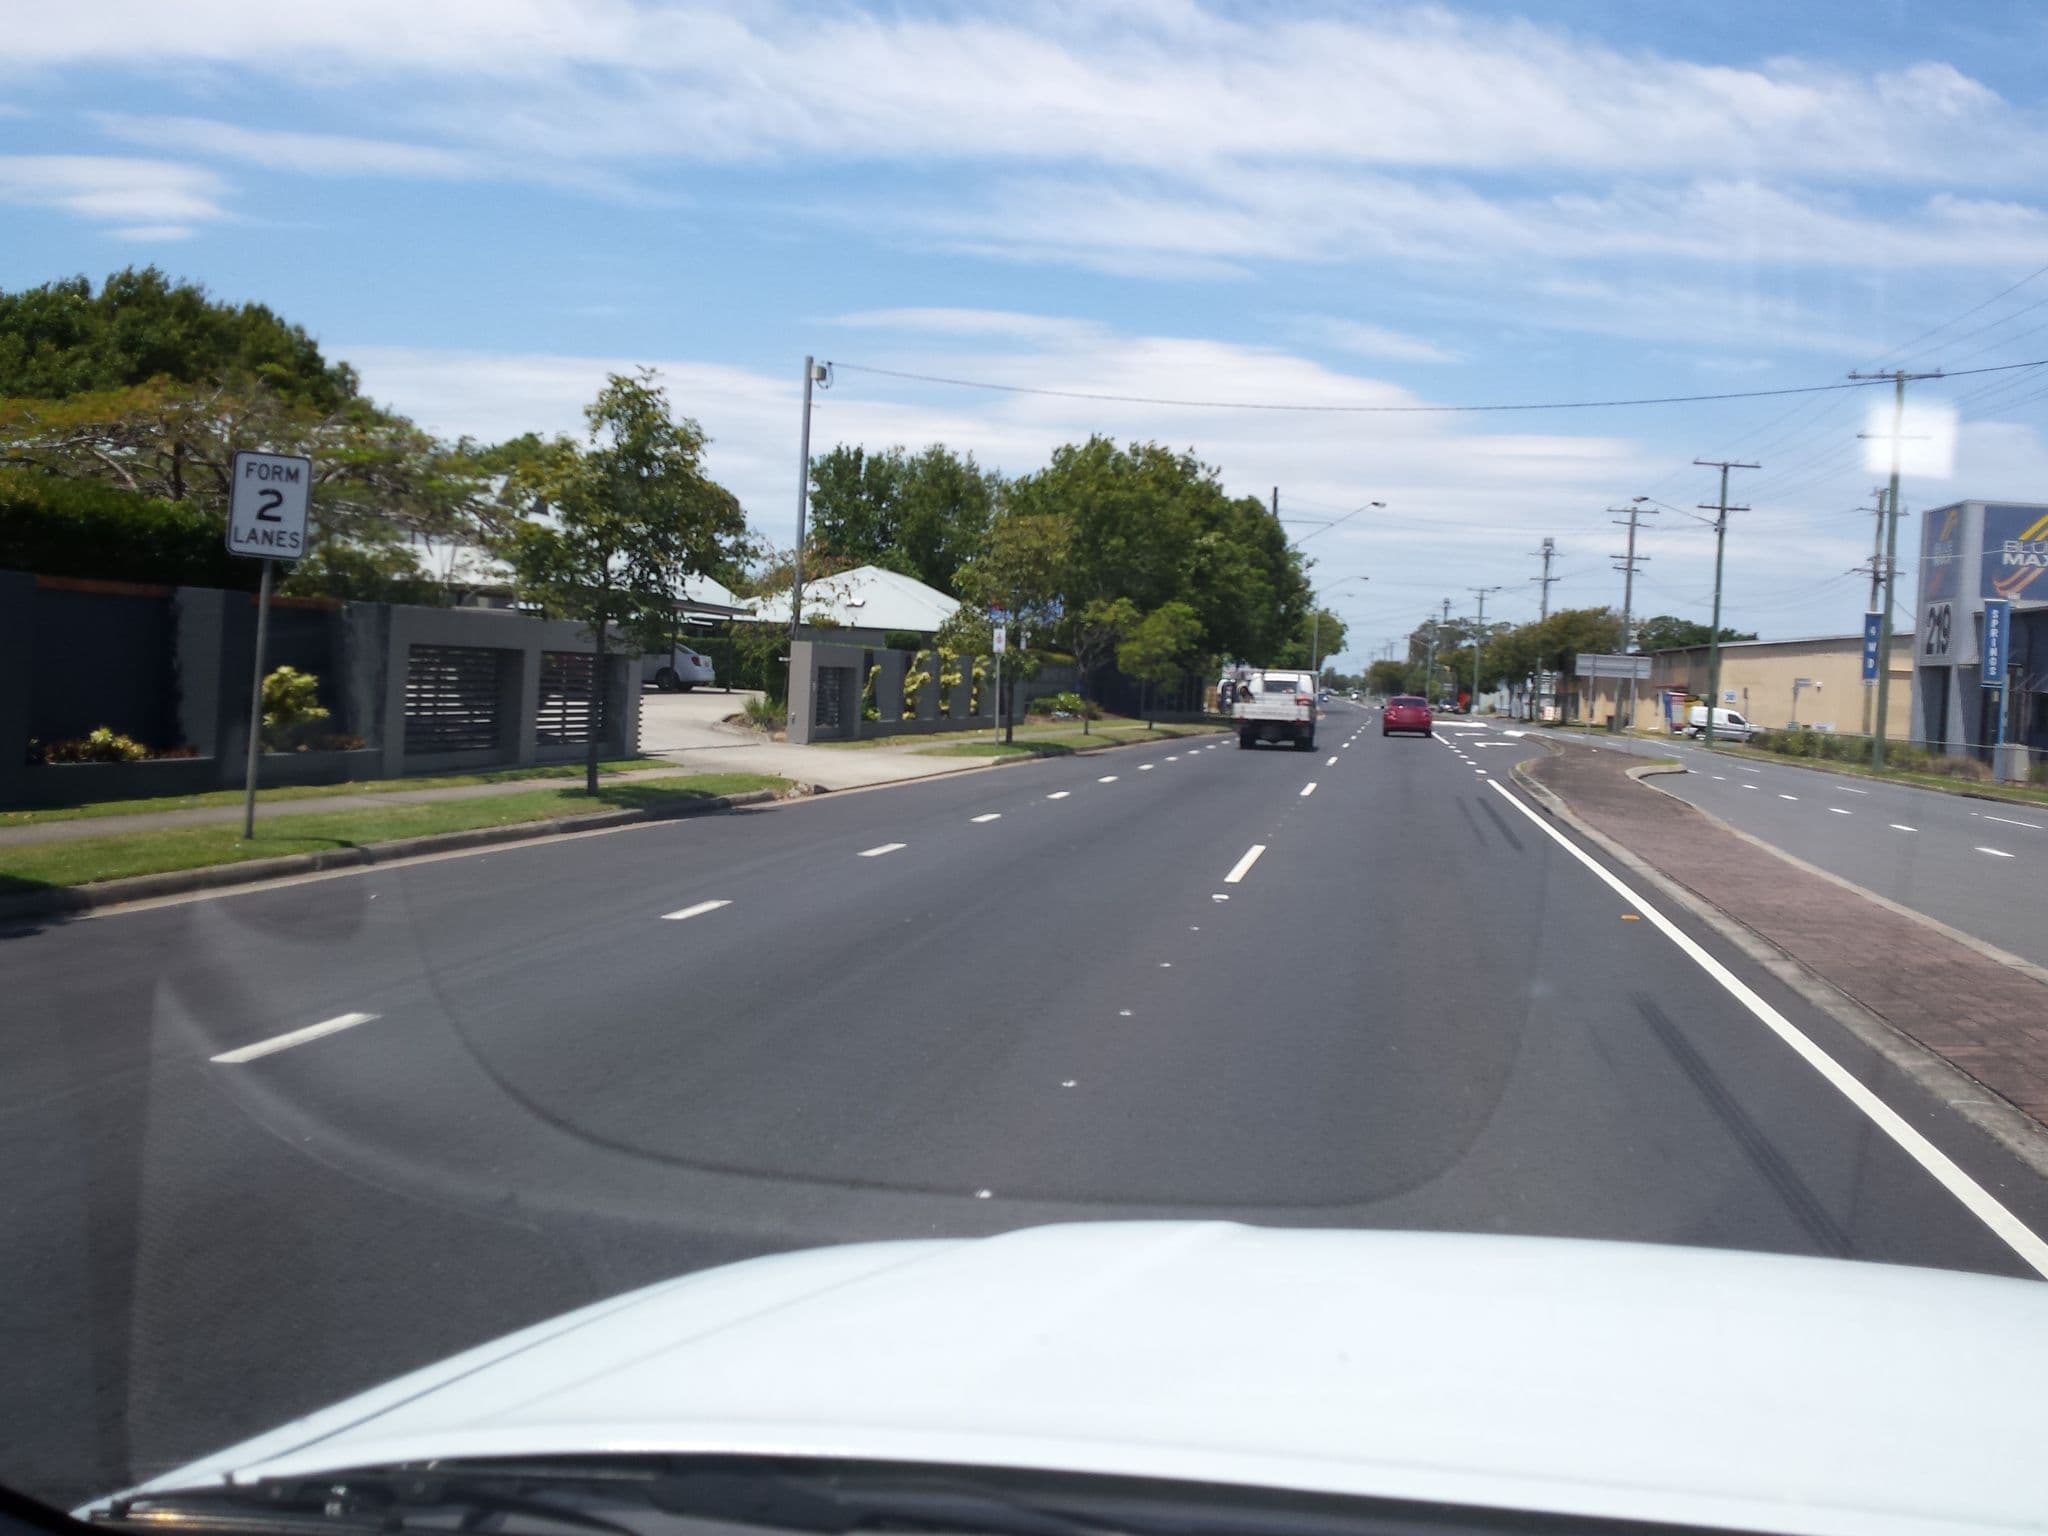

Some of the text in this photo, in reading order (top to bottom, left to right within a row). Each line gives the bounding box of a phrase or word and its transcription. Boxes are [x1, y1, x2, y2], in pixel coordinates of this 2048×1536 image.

[245, 462, 300, 484] FORM
[255, 488, 283, 522] 2
[233, 526, 300, 549] LANES
[2003, 539, 2048, 554] BLU
[1988, 609, 2000, 676] SPRINGS
